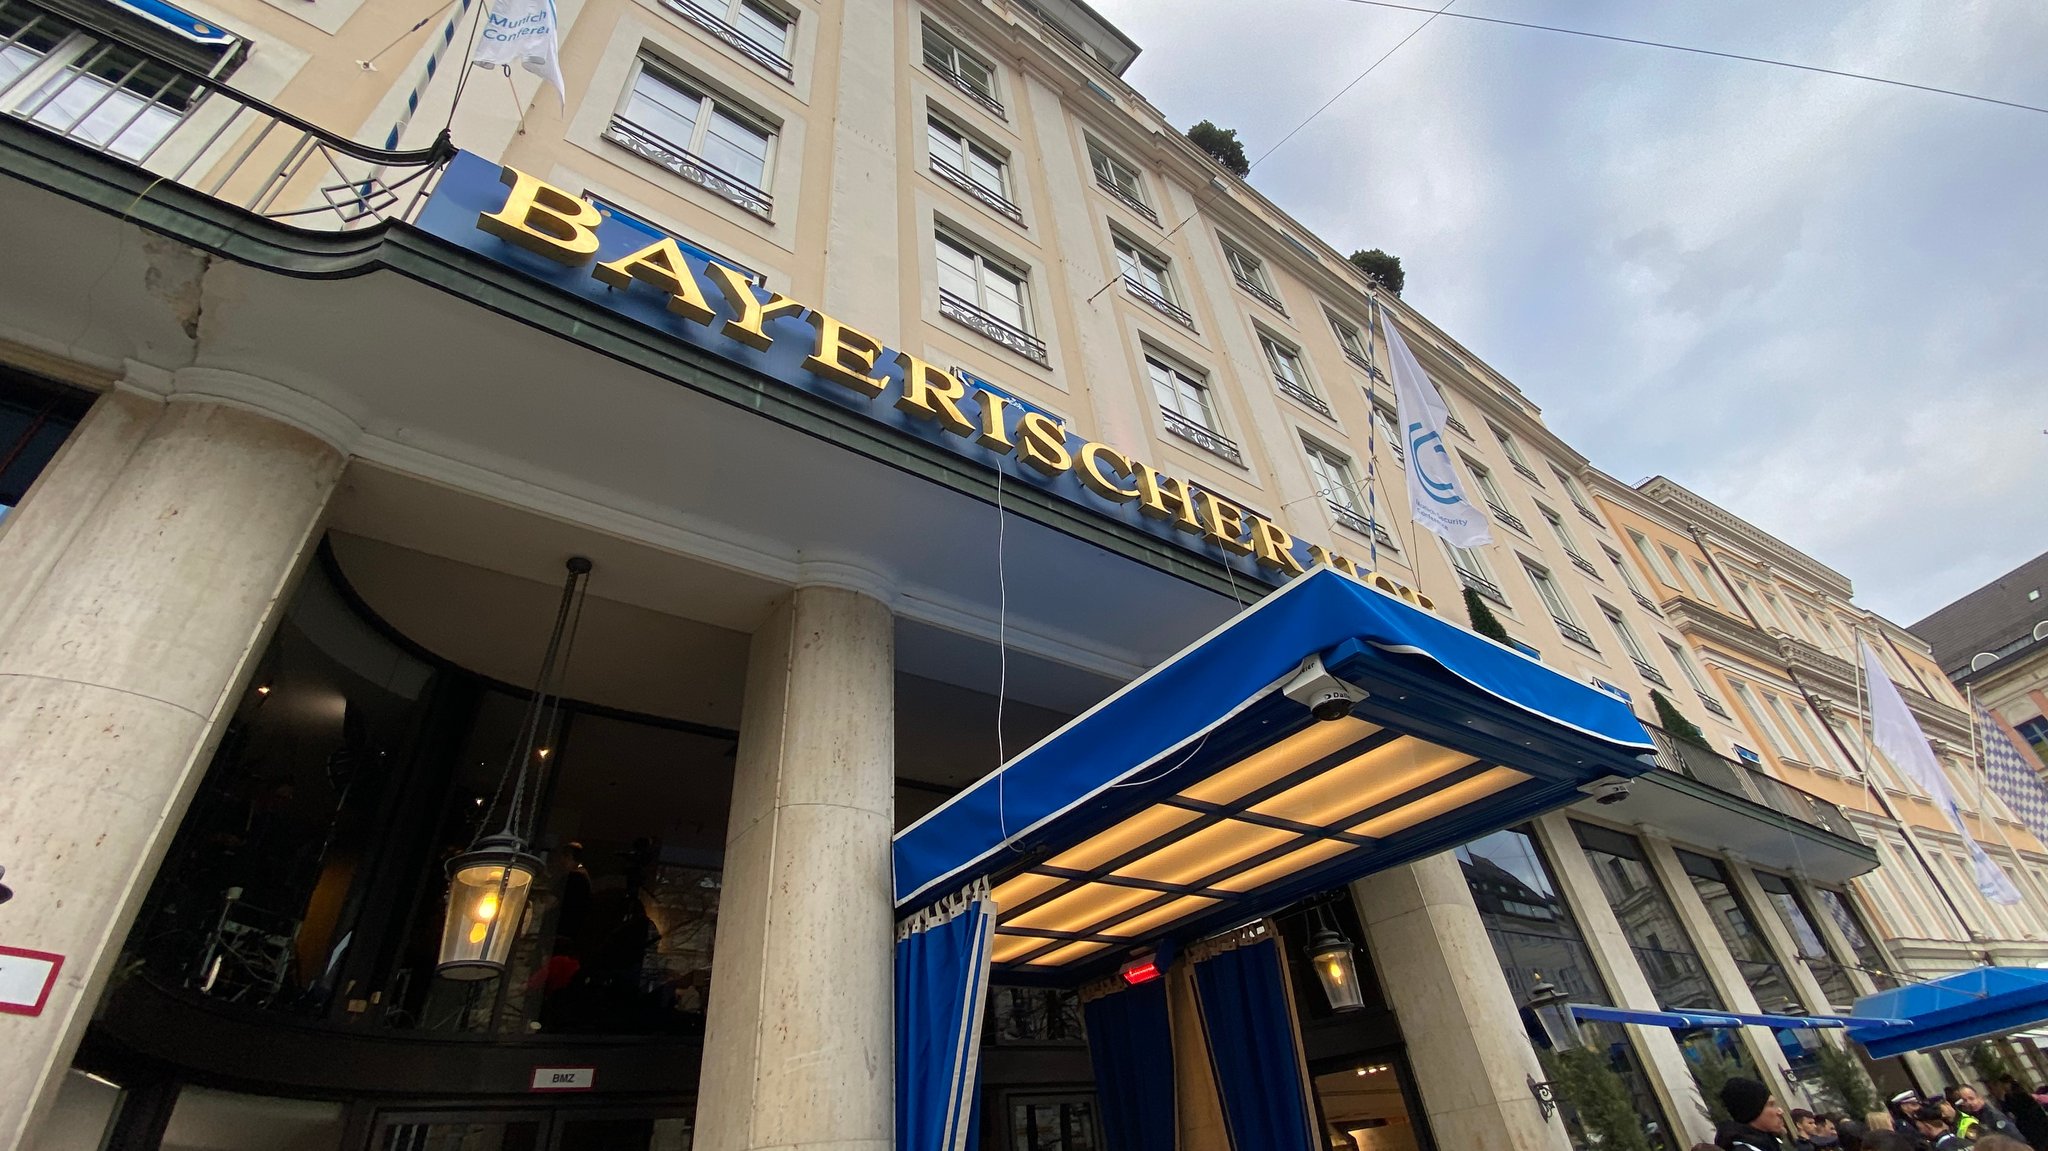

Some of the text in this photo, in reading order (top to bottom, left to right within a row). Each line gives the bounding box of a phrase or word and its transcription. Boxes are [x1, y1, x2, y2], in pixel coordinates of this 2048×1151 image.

[489, 10, 547, 28] Munich
[476, 165, 1304, 578] BAYERISCHER
[552, 1073, 575, 1083] BMZ
